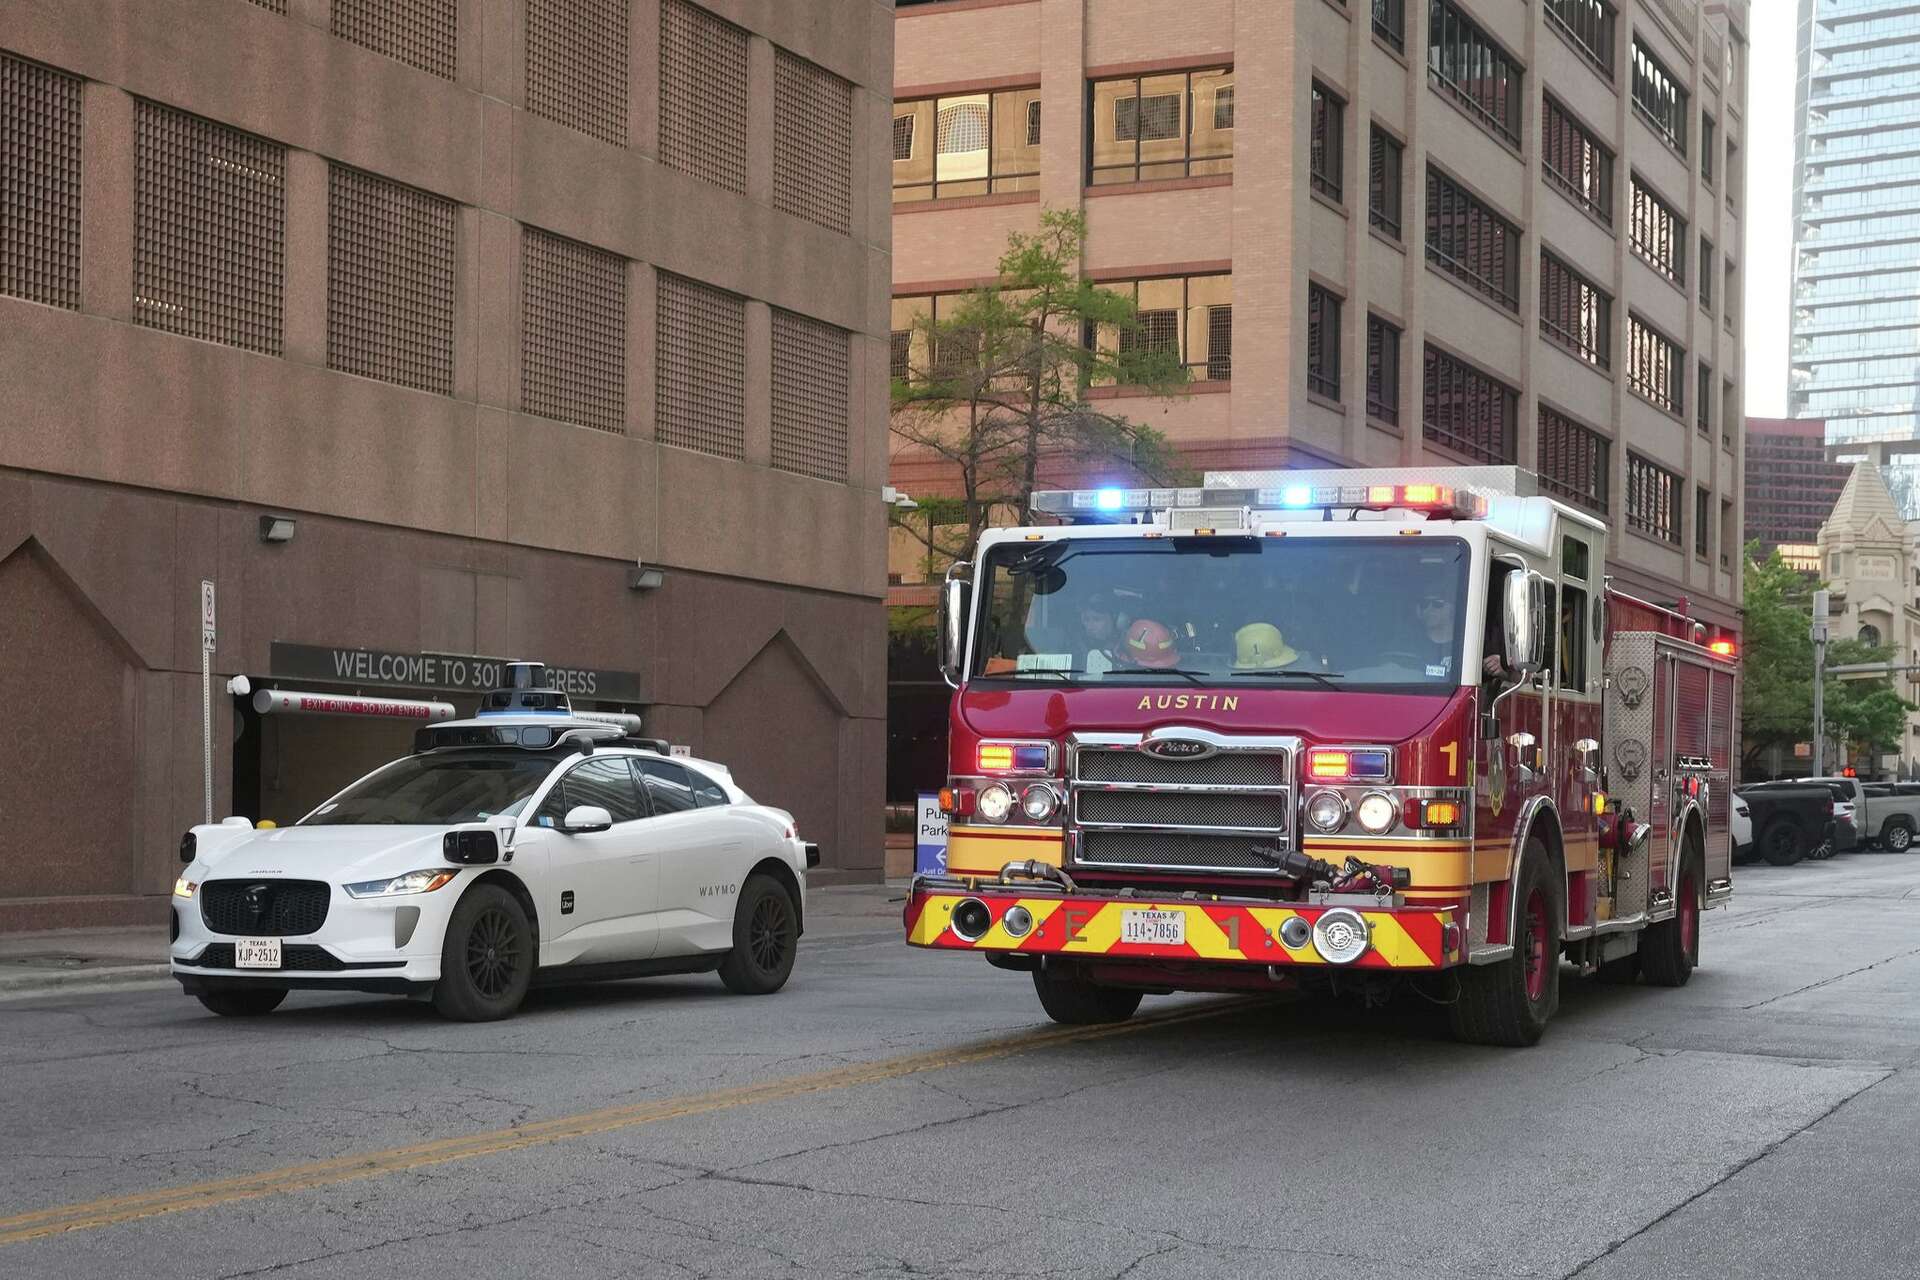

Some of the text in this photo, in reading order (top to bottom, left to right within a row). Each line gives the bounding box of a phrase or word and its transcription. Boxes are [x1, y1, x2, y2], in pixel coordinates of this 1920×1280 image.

[333, 650, 597, 694] WELCOME TO 301 GRESS
[306, 699, 328, 709] EXIT
[330, 701, 353, 711] ONLY
[362, 702, 376, 713] DO
[379, 703, 396, 714] NOT
[398, 705, 426, 717] ENTER
[1137, 695, 1239, 711] AUSTIN
[1439, 741, 1458, 776] 1
[925, 807, 949, 820] Pub
[921, 824, 948, 836] Park
[921, 866, 936, 875] Just
[699, 883, 736, 897] WAYMO
[561, 901, 573, 909] Uber
[1141, 911, 1168, 920] TEXAS
[1065, 910, 1088, 942] E
[1218, 916, 1240, 950] 1
